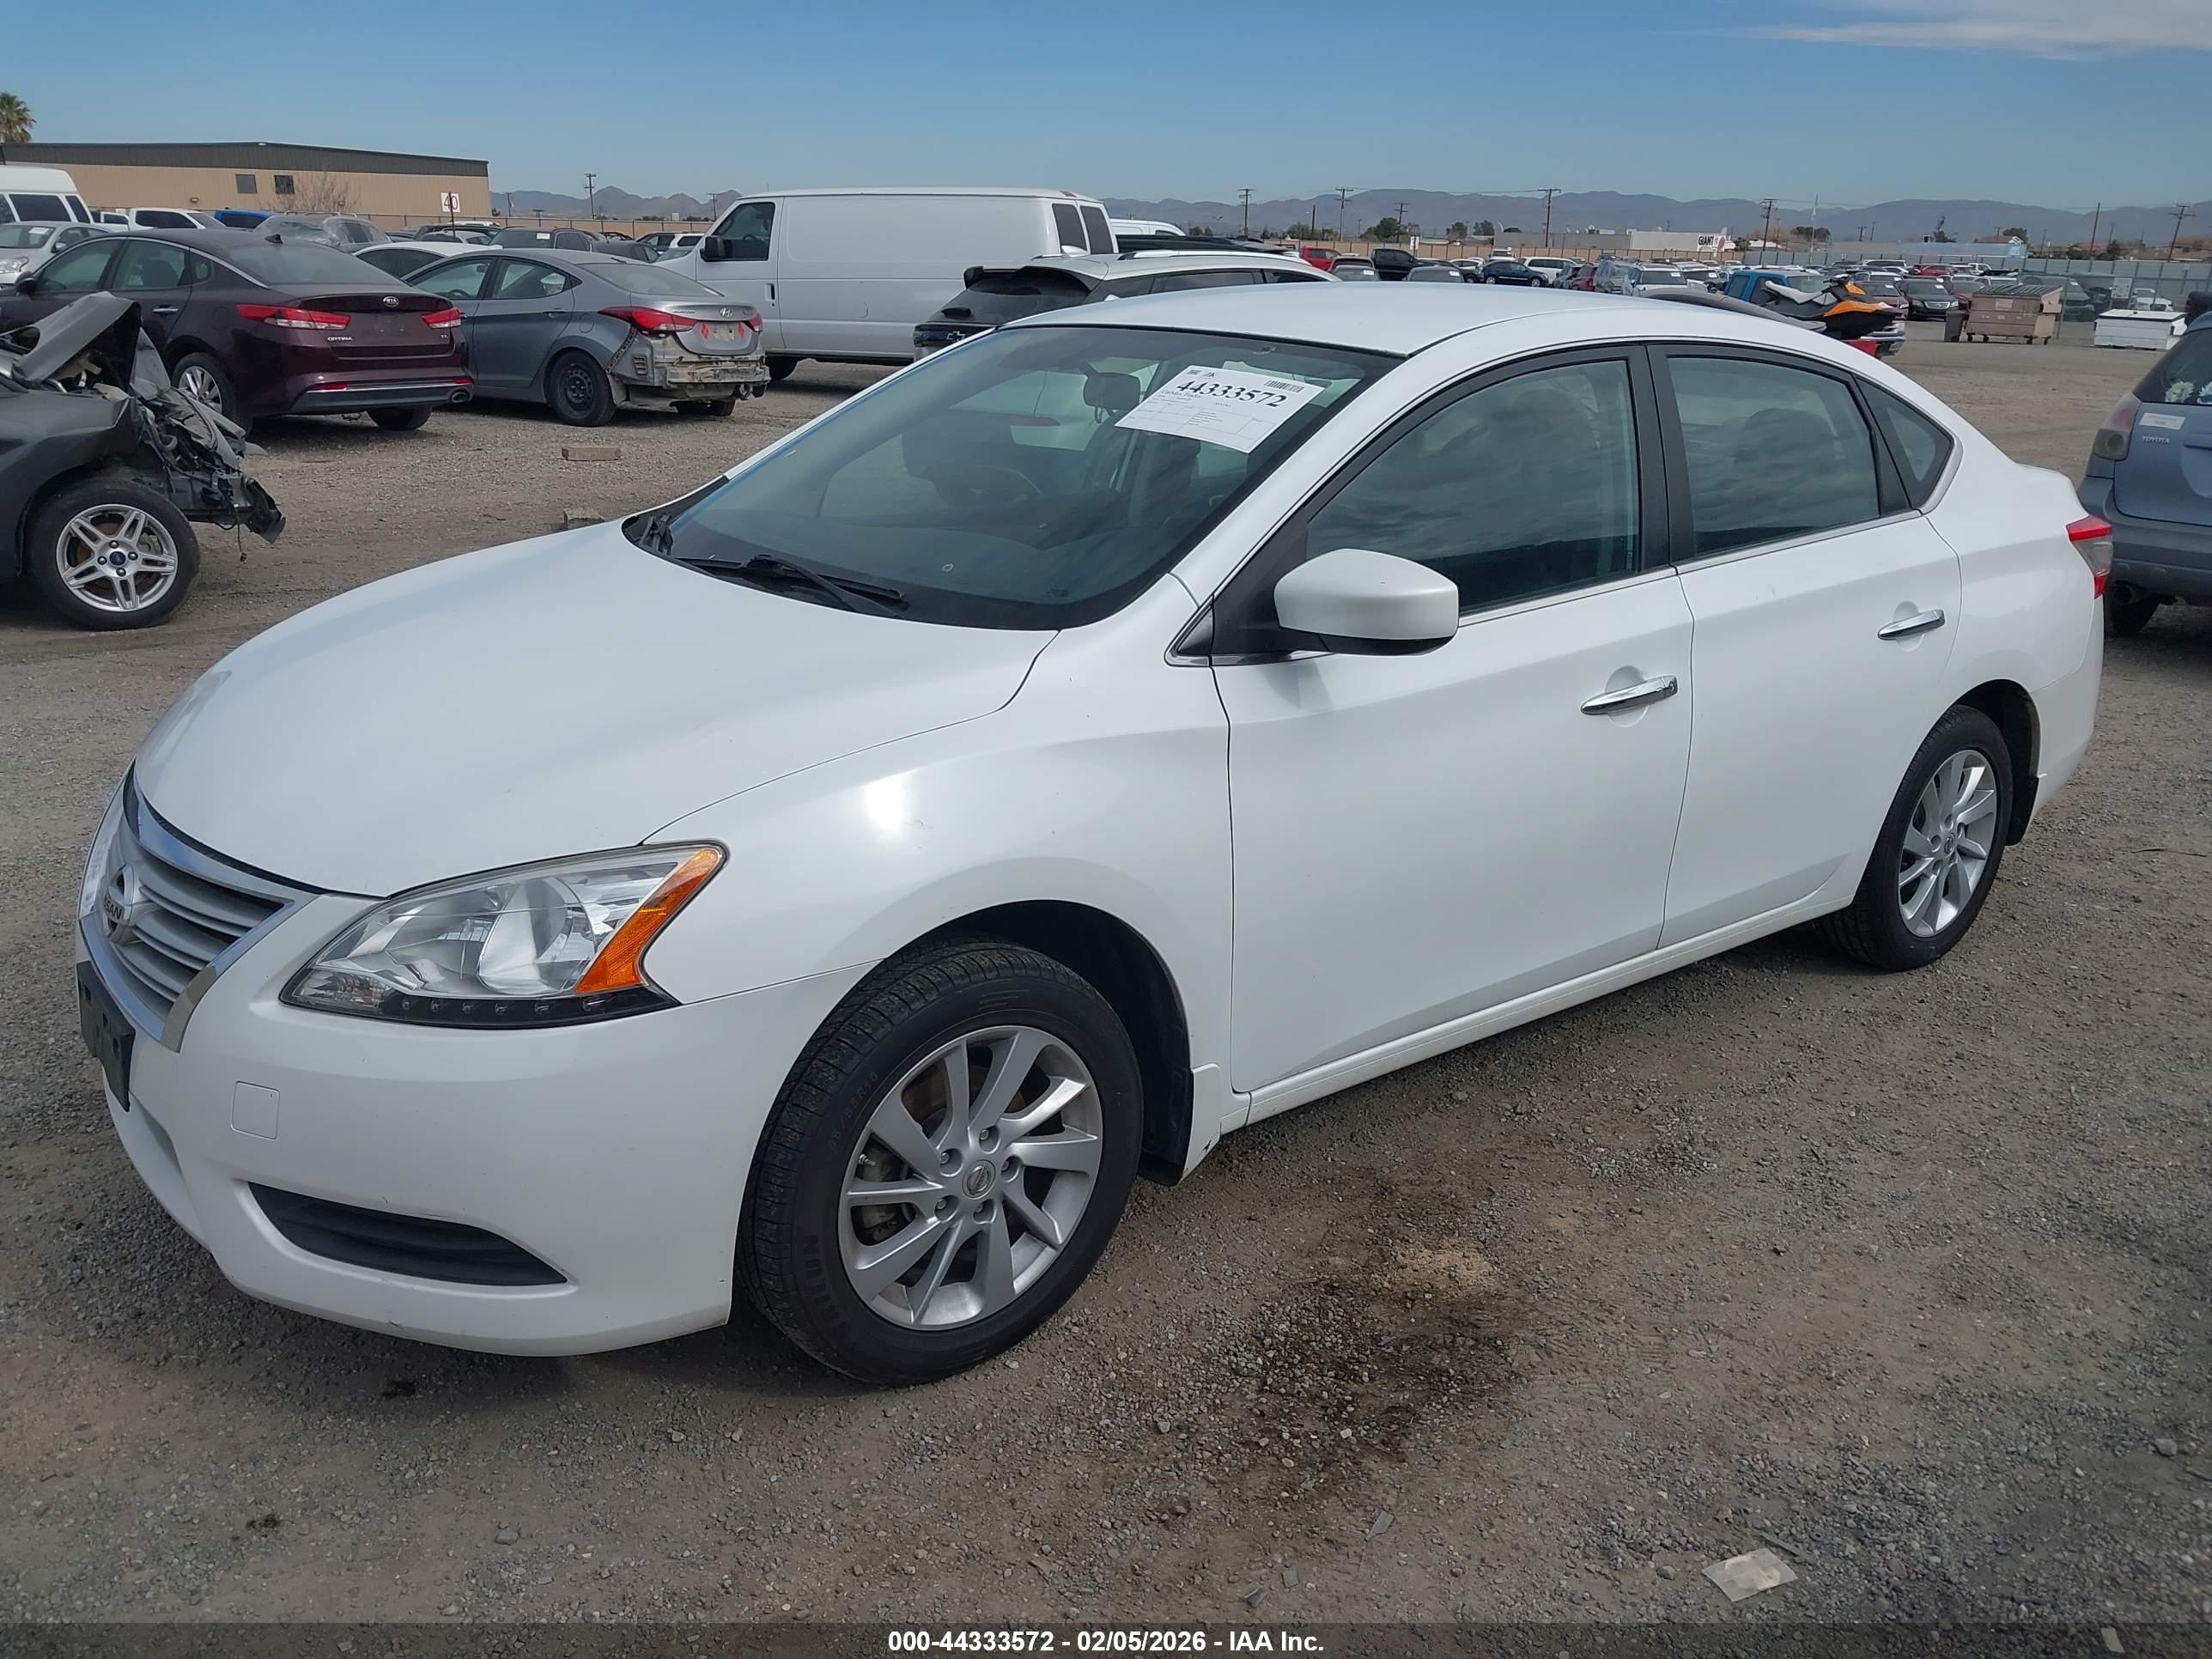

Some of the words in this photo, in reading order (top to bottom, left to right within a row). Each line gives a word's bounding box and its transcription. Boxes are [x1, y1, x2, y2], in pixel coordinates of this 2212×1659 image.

[443, 195, 459, 210] 40
[1698, 235, 1715, 246] GIANT
[1176, 380, 1287, 408] 44333572
[2142, 435, 2170, 444] TOYOTA
